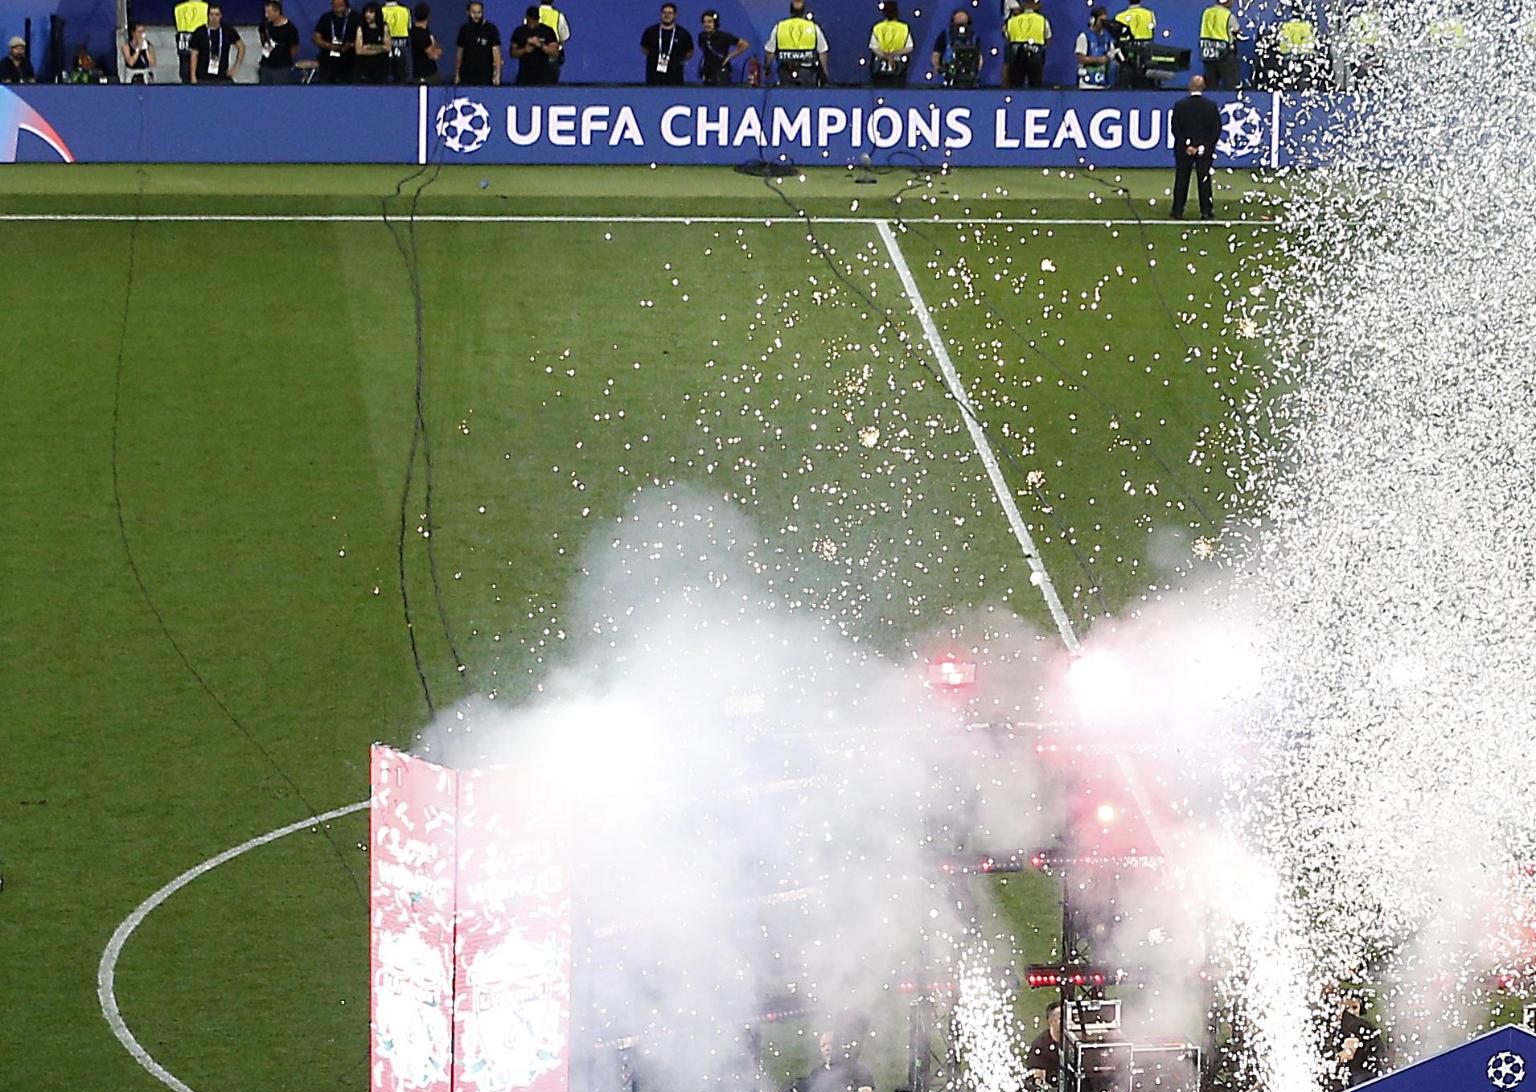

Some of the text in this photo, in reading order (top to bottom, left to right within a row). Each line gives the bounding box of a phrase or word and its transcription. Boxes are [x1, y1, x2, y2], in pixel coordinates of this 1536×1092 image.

[506, 105, 1174, 150] UEFA CHAMPIONS LEAGU
